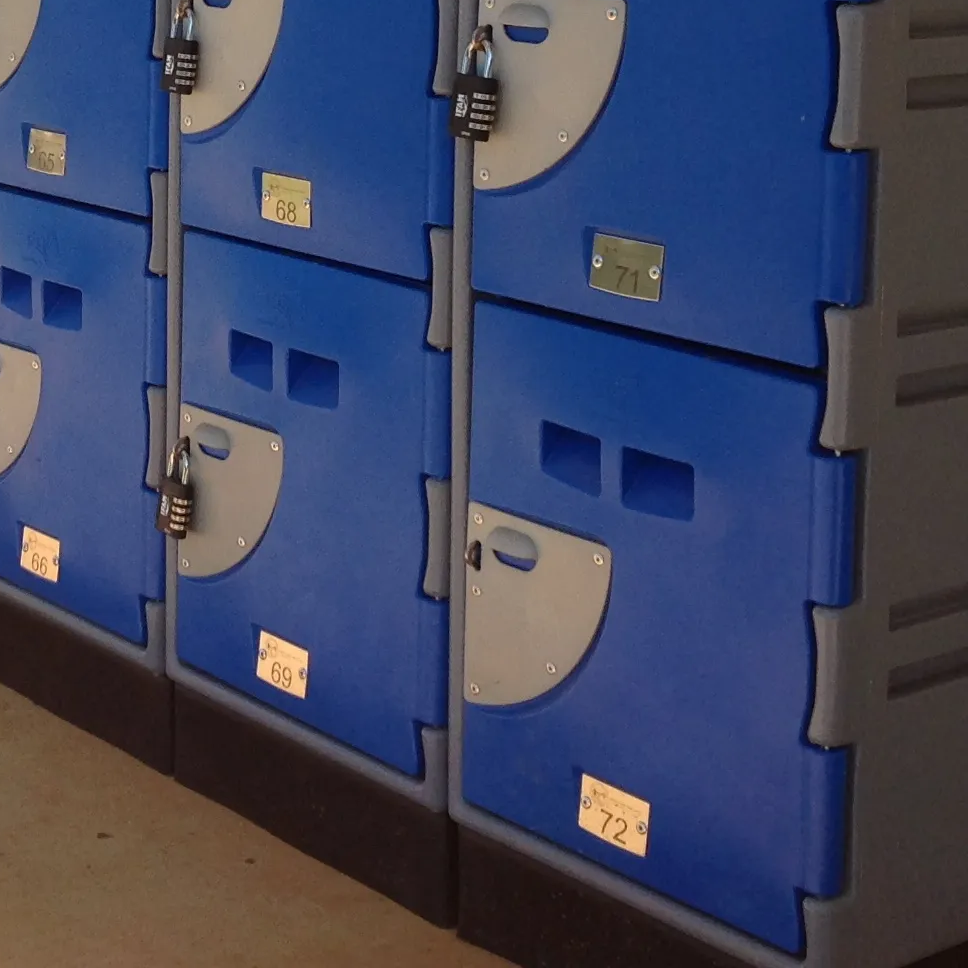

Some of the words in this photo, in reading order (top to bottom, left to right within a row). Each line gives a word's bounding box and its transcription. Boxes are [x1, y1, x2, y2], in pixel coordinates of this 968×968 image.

[38, 150, 55, 173] 65
[275, 199, 297, 224] 68
[614, 264, 640, 293] 71
[31, 551, 49, 576] 66
[270, 660, 293, 689] 69
[599, 808, 629, 845] 72
